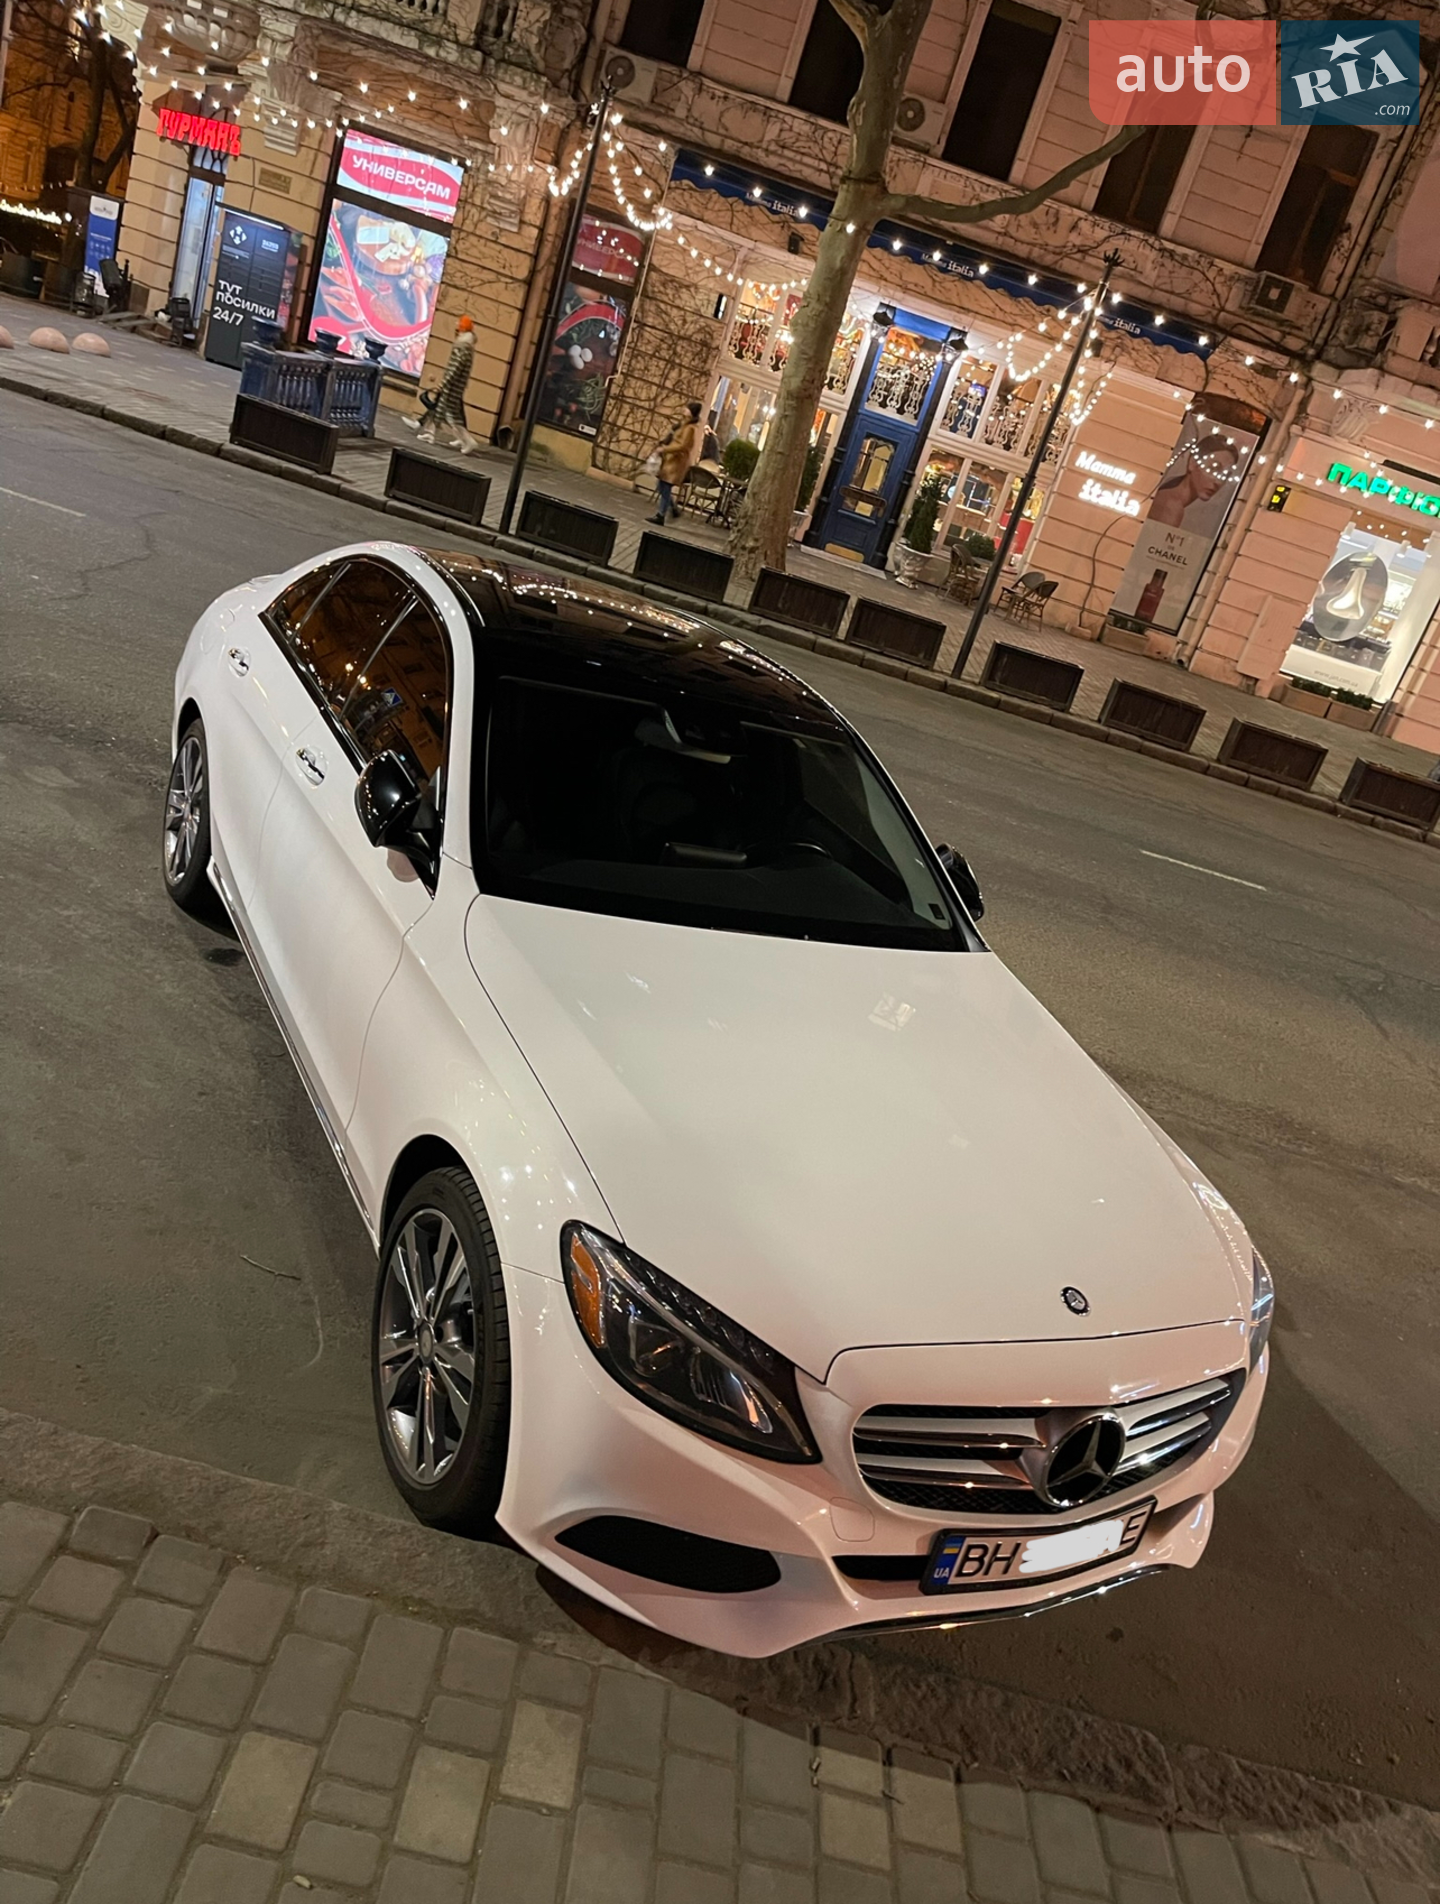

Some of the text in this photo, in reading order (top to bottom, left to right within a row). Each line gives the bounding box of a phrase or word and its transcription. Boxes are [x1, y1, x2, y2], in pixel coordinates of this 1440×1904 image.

[352, 155, 452, 200] УНИВЕРСАМ
[218, 279, 243, 295] ТУТ
[212, 306, 244, 326] 24/7
[215, 291, 277, 319] ПОСИЛКИ
[1075, 451, 1136, 485] Mamma
[1327, 462, 1440, 519] ПАРФЮ
[1147, 546, 1188, 566] CHANEL
[934, 1566, 951, 1579] UA
[954, 1540, 1022, 1578] BH
